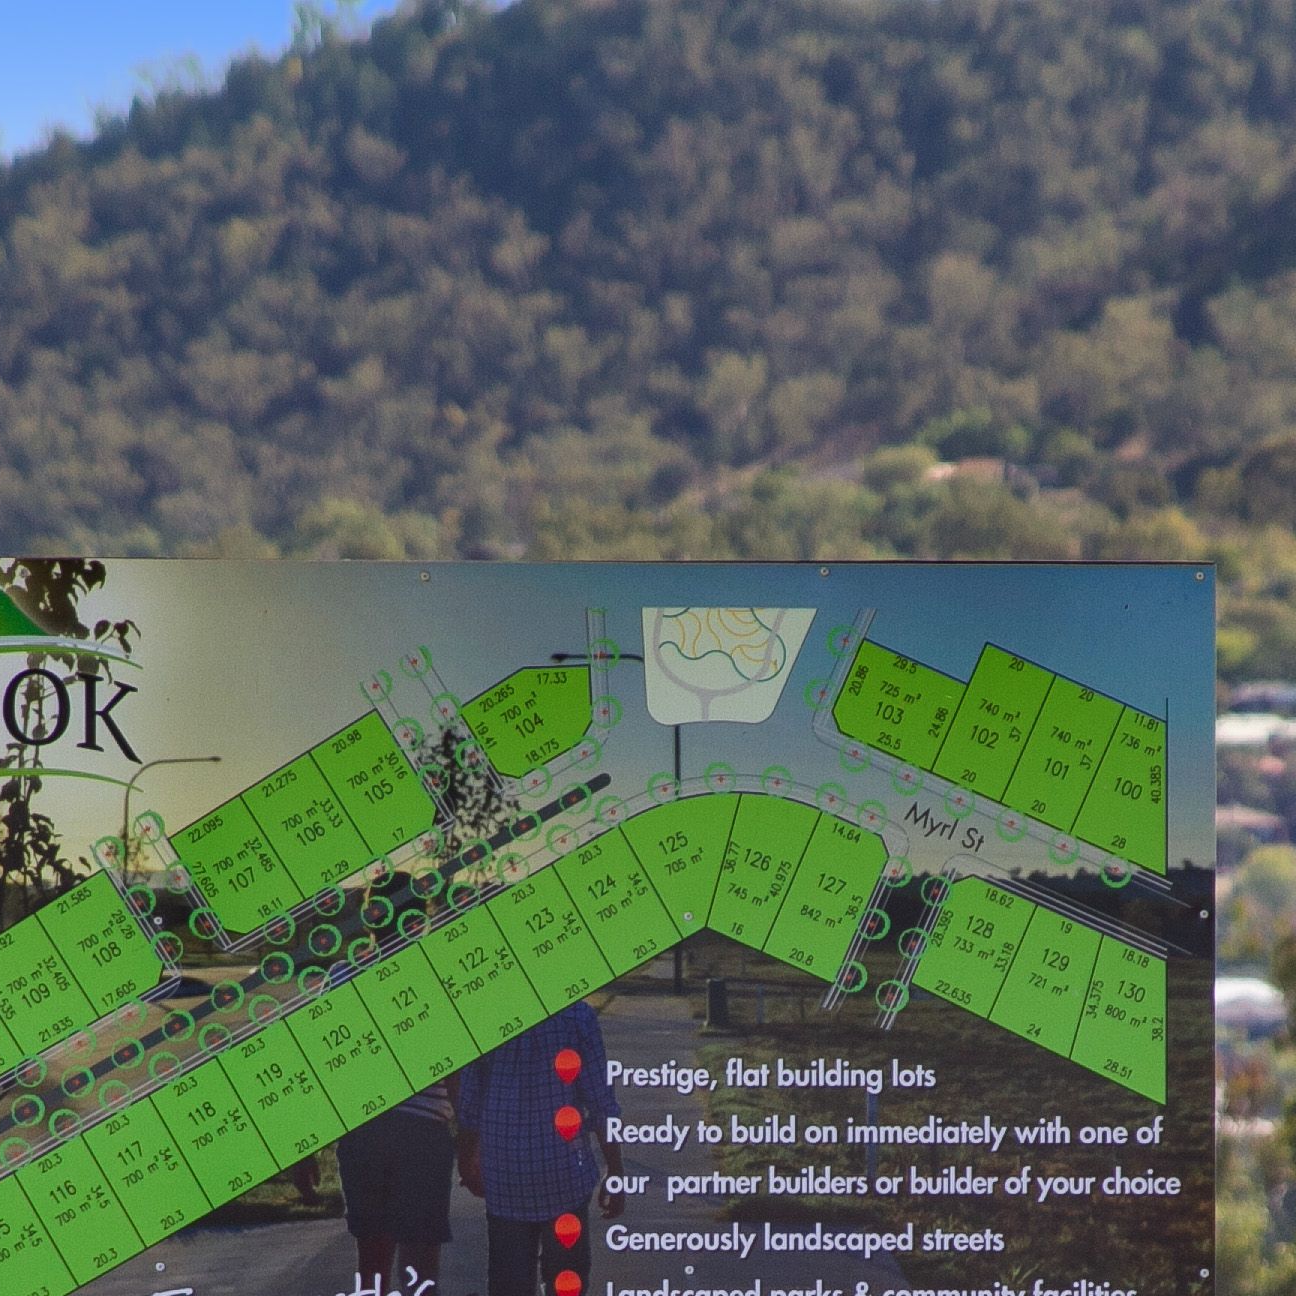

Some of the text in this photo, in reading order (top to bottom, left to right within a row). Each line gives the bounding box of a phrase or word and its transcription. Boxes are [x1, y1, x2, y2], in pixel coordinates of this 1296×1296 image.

[1008, 657, 1025, 671] 20
[536, 672, 568, 684] 17.33
[879, 681, 900, 698] 725
[500, 705, 522, 724] 700
[875, 701, 905, 725] 103
[978, 699, 1000, 715] 740
[515, 712, 545, 738] 104
[1050, 726, 1072, 744] 740
[877, 732, 902, 750] 25.5
[970, 725, 1000, 749] 102
[1120, 733, 1141, 749] 736
[1044, 758, 1069, 780] 101
[346, 771, 369, 789] 700
[1114, 777, 1143, 800] 100
[364, 779, 393, 804] 105
[1031, 800, 1046, 814] 20
[188, 816, 225, 844] 22.095
[282, 815, 303, 832] 700
[296, 821, 326, 846] 106
[904, 801, 984, 852] Myrl St
[659, 831, 689, 856] 125
[1111, 835, 1127, 849] 28
[213, 857, 234, 874] 700
[665, 858, 687, 876] 705
[743, 848, 772, 872] 126
[227, 867, 255, 893] 107
[587, 875, 617, 900] 124
[817, 873, 847, 895] 127
[57, 887, 92, 914] 21.585
[511, 884, 536, 904] 20.3
[727, 883, 749, 900] 745
[525, 907, 555, 934] 123
[596, 904, 618, 922] 700
[800, 904, 822, 922] 842
[731, 922, 745, 936] 16
[965, 914, 995, 939] 128
[1060, 920, 1073, 934] 19
[77, 934, 99, 952] 700
[532, 939, 554, 958] 700
[633, 939, 657, 960] 20.3
[954, 936, 975, 954] 733
[92, 942, 122, 967] 108
[458, 947, 489, 973] 122
[789, 948, 814, 966] 20.8
[1041, 947, 1070, 972] 129
[6, 977, 28, 994] 700
[463, 976, 485, 996] 700
[1028, 972, 1048, 990] 721
[1117, 980, 1146, 1003] 130
[22, 983, 51, 1009] 109
[392, 986, 419, 1011] 121
[1104, 1004, 1127, 1021] 800
[38, 1017, 74, 1042] 21.935
[322, 1024, 352, 1050] 120
[392, 1018, 415, 1036] 700
[1026, 1023, 1042, 1038] 24
[325, 1054, 347, 1072] 700
[429, 1057, 454, 1078] 20.3
[256, 1063, 283, 1088] 119
[606, 1058, 936, 1095] Prestige, flat building lots
[173, 1076, 199, 1097] 20.3
[257, 1092, 279, 1110] 700
[188, 1102, 217, 1126] 118
[192, 1132, 214, 1150] 700
[606, 1114, 1164, 1152] Ready to build on immediately with one of
[117, 1141, 143, 1166] 117
[294, 1134, 320, 1154] 20.3
[122, 1169, 144, 1188] 700
[605, 1165, 1181, 1203] our partner builders or builder of your choice
[49, 1180, 78, 1205] 116
[55, 1209, 77, 1227] 700
[606, 1222, 1005, 1259] Generously landscaped streets
[93, 1248, 119, 1269] 20.3
